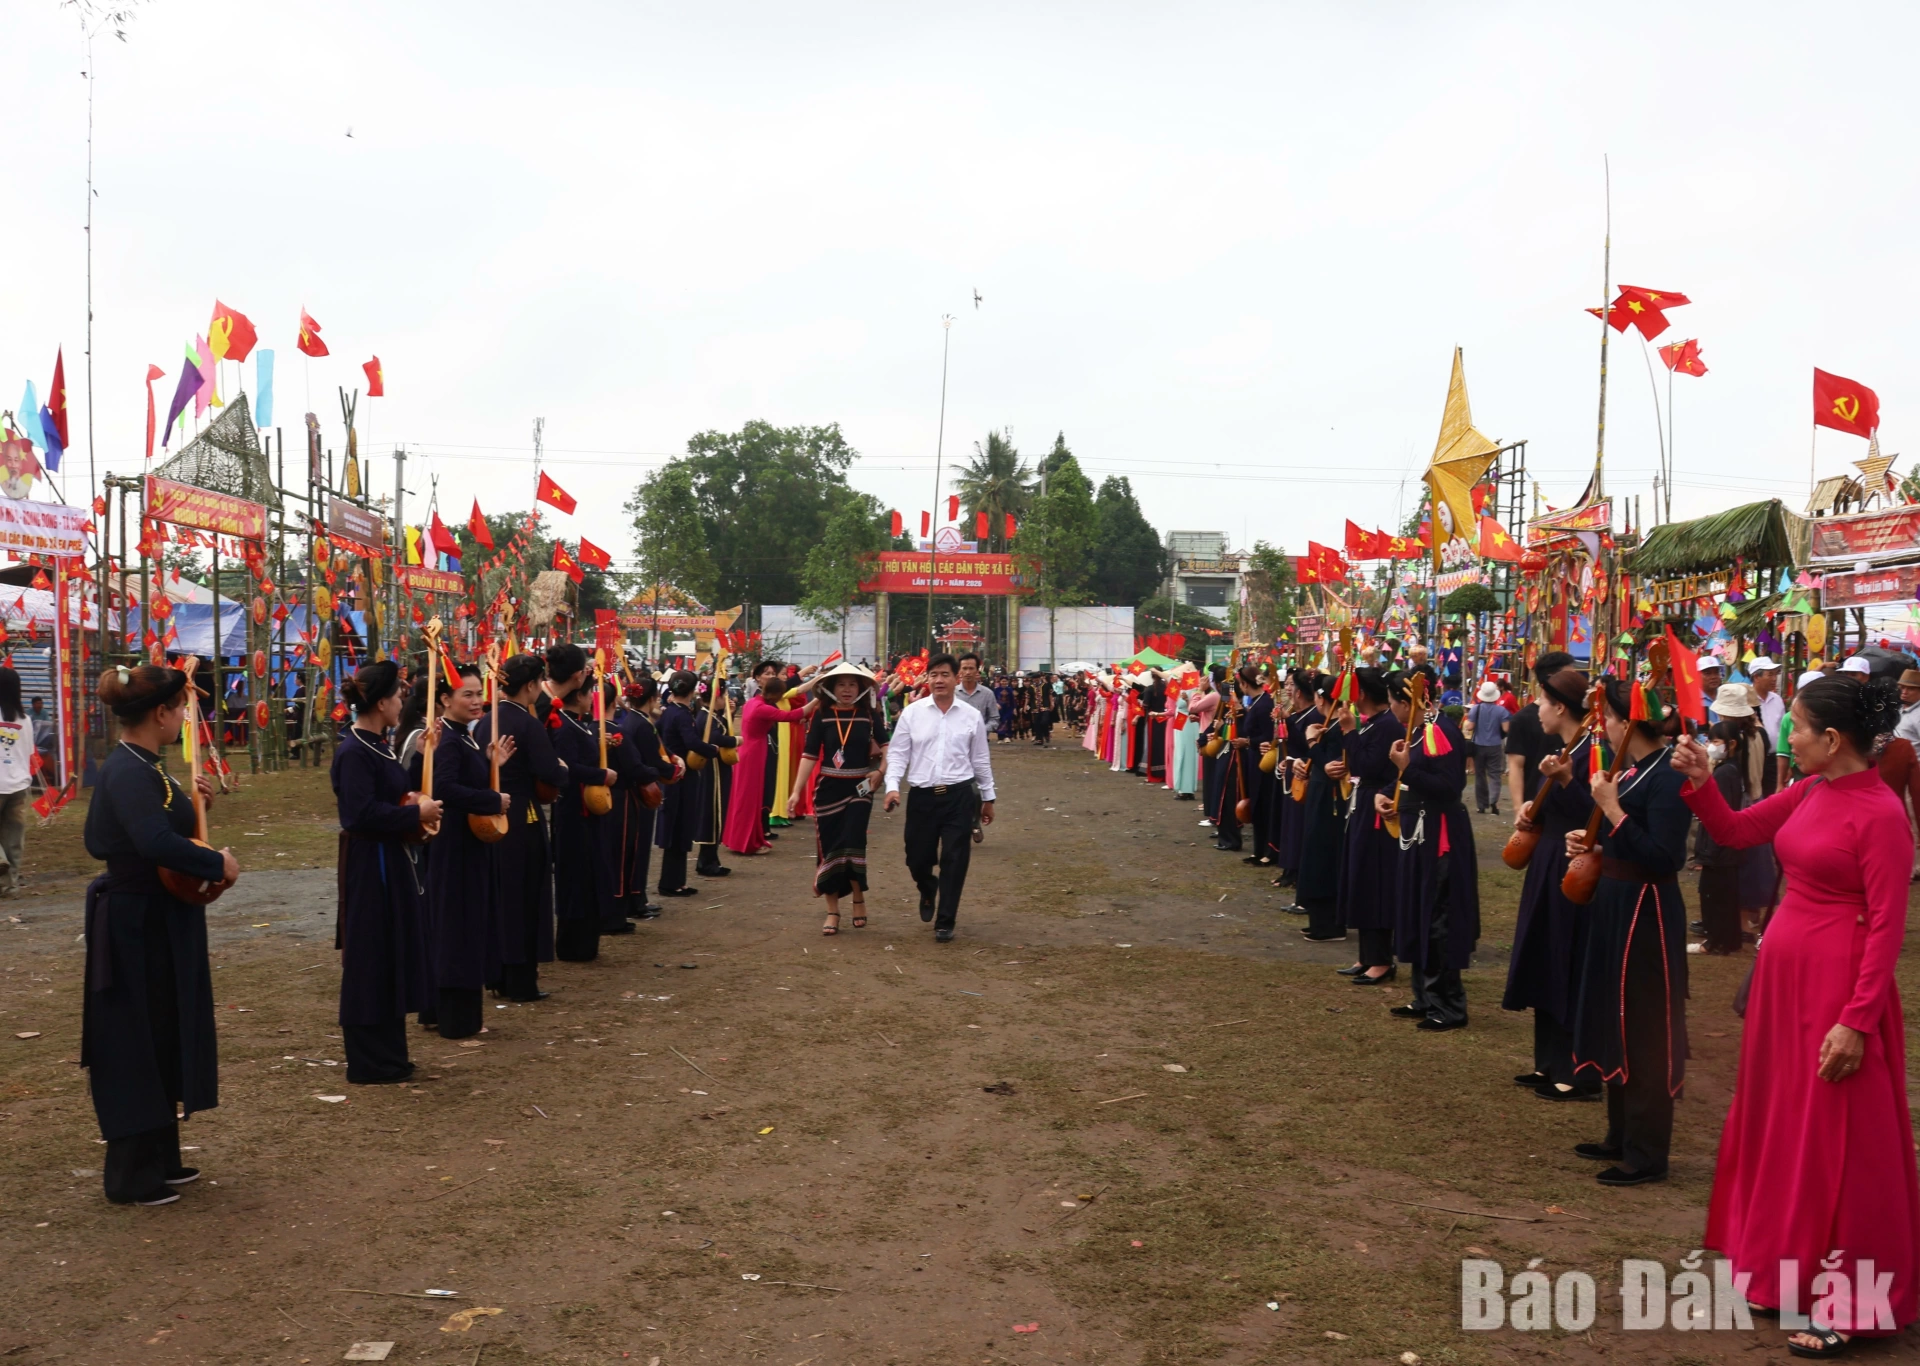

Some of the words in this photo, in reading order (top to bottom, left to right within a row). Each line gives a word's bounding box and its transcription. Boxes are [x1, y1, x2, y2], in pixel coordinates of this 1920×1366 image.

[885, 559, 900, 575] HỘI
[901, 559, 918, 573] VĂN
[955, 560, 973, 574] DÂN
[973, 561, 990, 577] TỘC
[991, 562, 1003, 575] XÃ
[948, 578, 965, 587] NĂM
[965, 579, 983, 588] 2026
